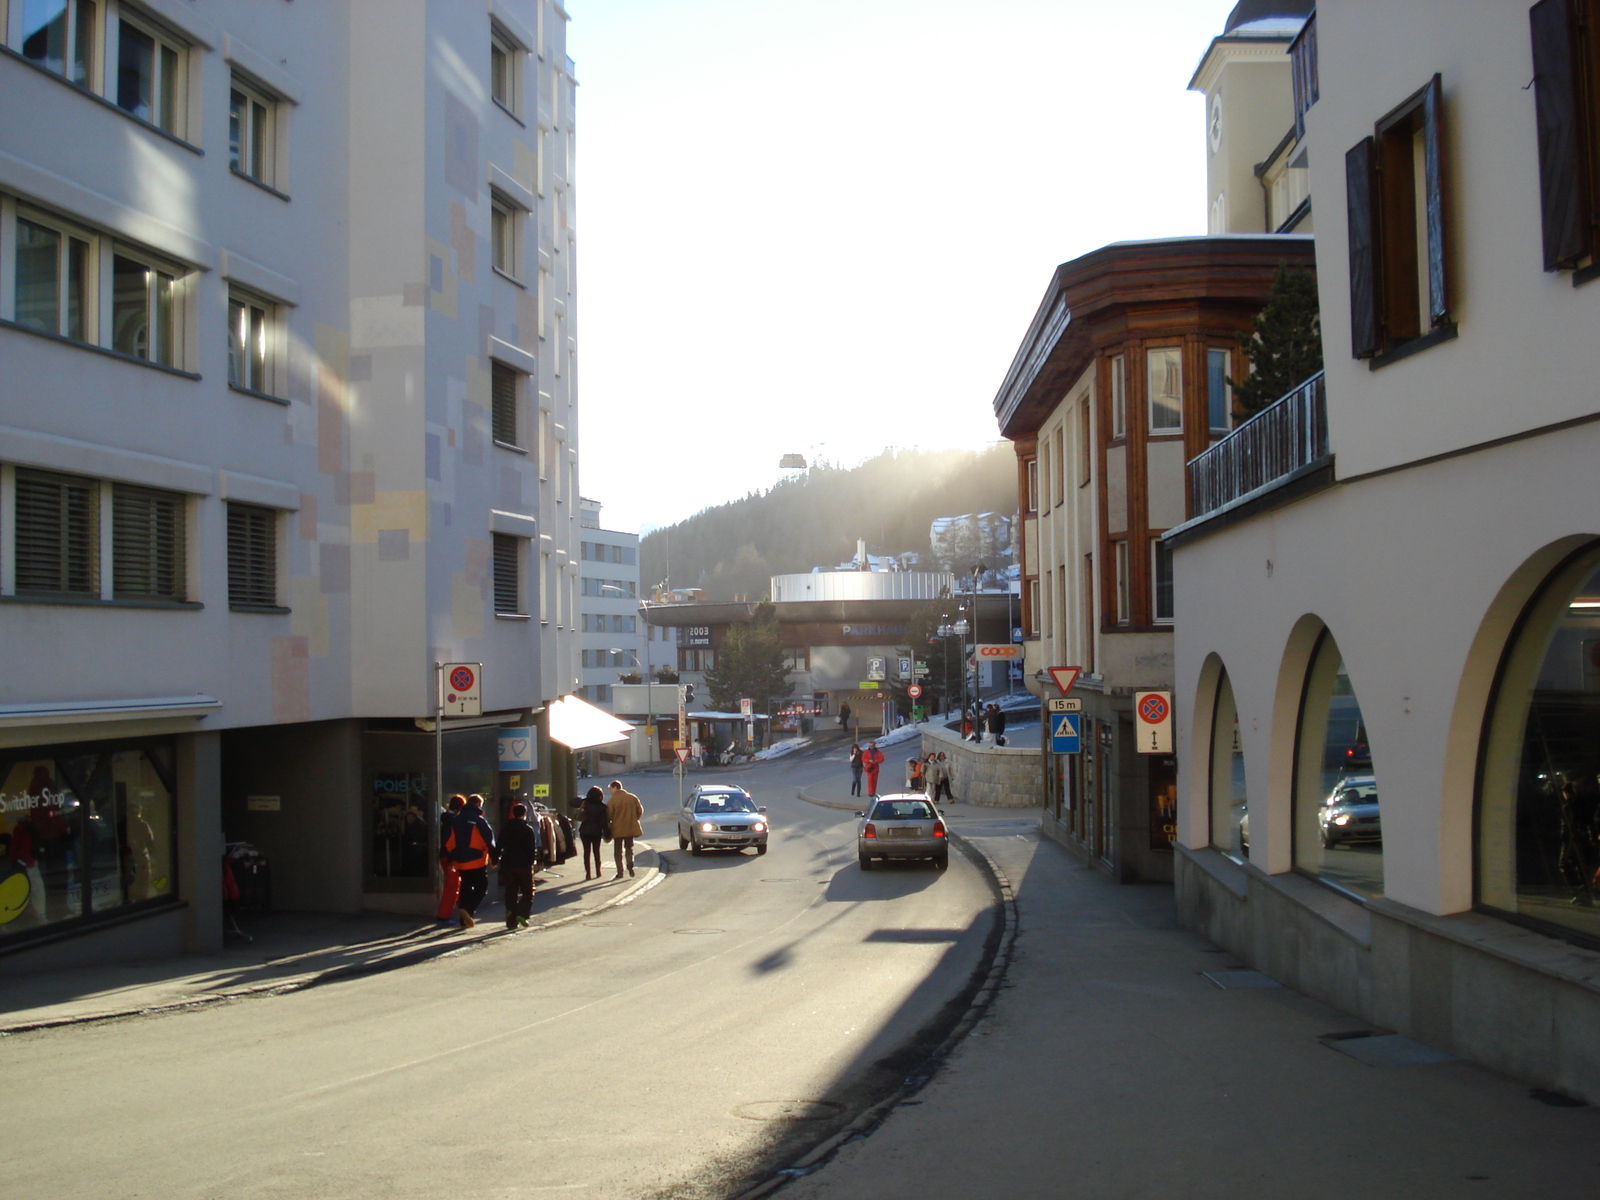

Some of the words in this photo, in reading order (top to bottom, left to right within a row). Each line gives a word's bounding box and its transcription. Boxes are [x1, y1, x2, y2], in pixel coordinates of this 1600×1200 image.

[690, 627, 709, 636] 2003
[843, 625, 909, 636] PARKHAU
[981, 647, 1017, 658] coop
[873, 661, 880, 671] P
[1055, 701, 1064, 710] 15
[1067, 702, 1076, 710] m
[374, 779, 408, 792] POIS
[0, 789, 40, 813] Switcher
[42, 787, 65, 809] Shop
[1163, 824, 1177, 834] CH
